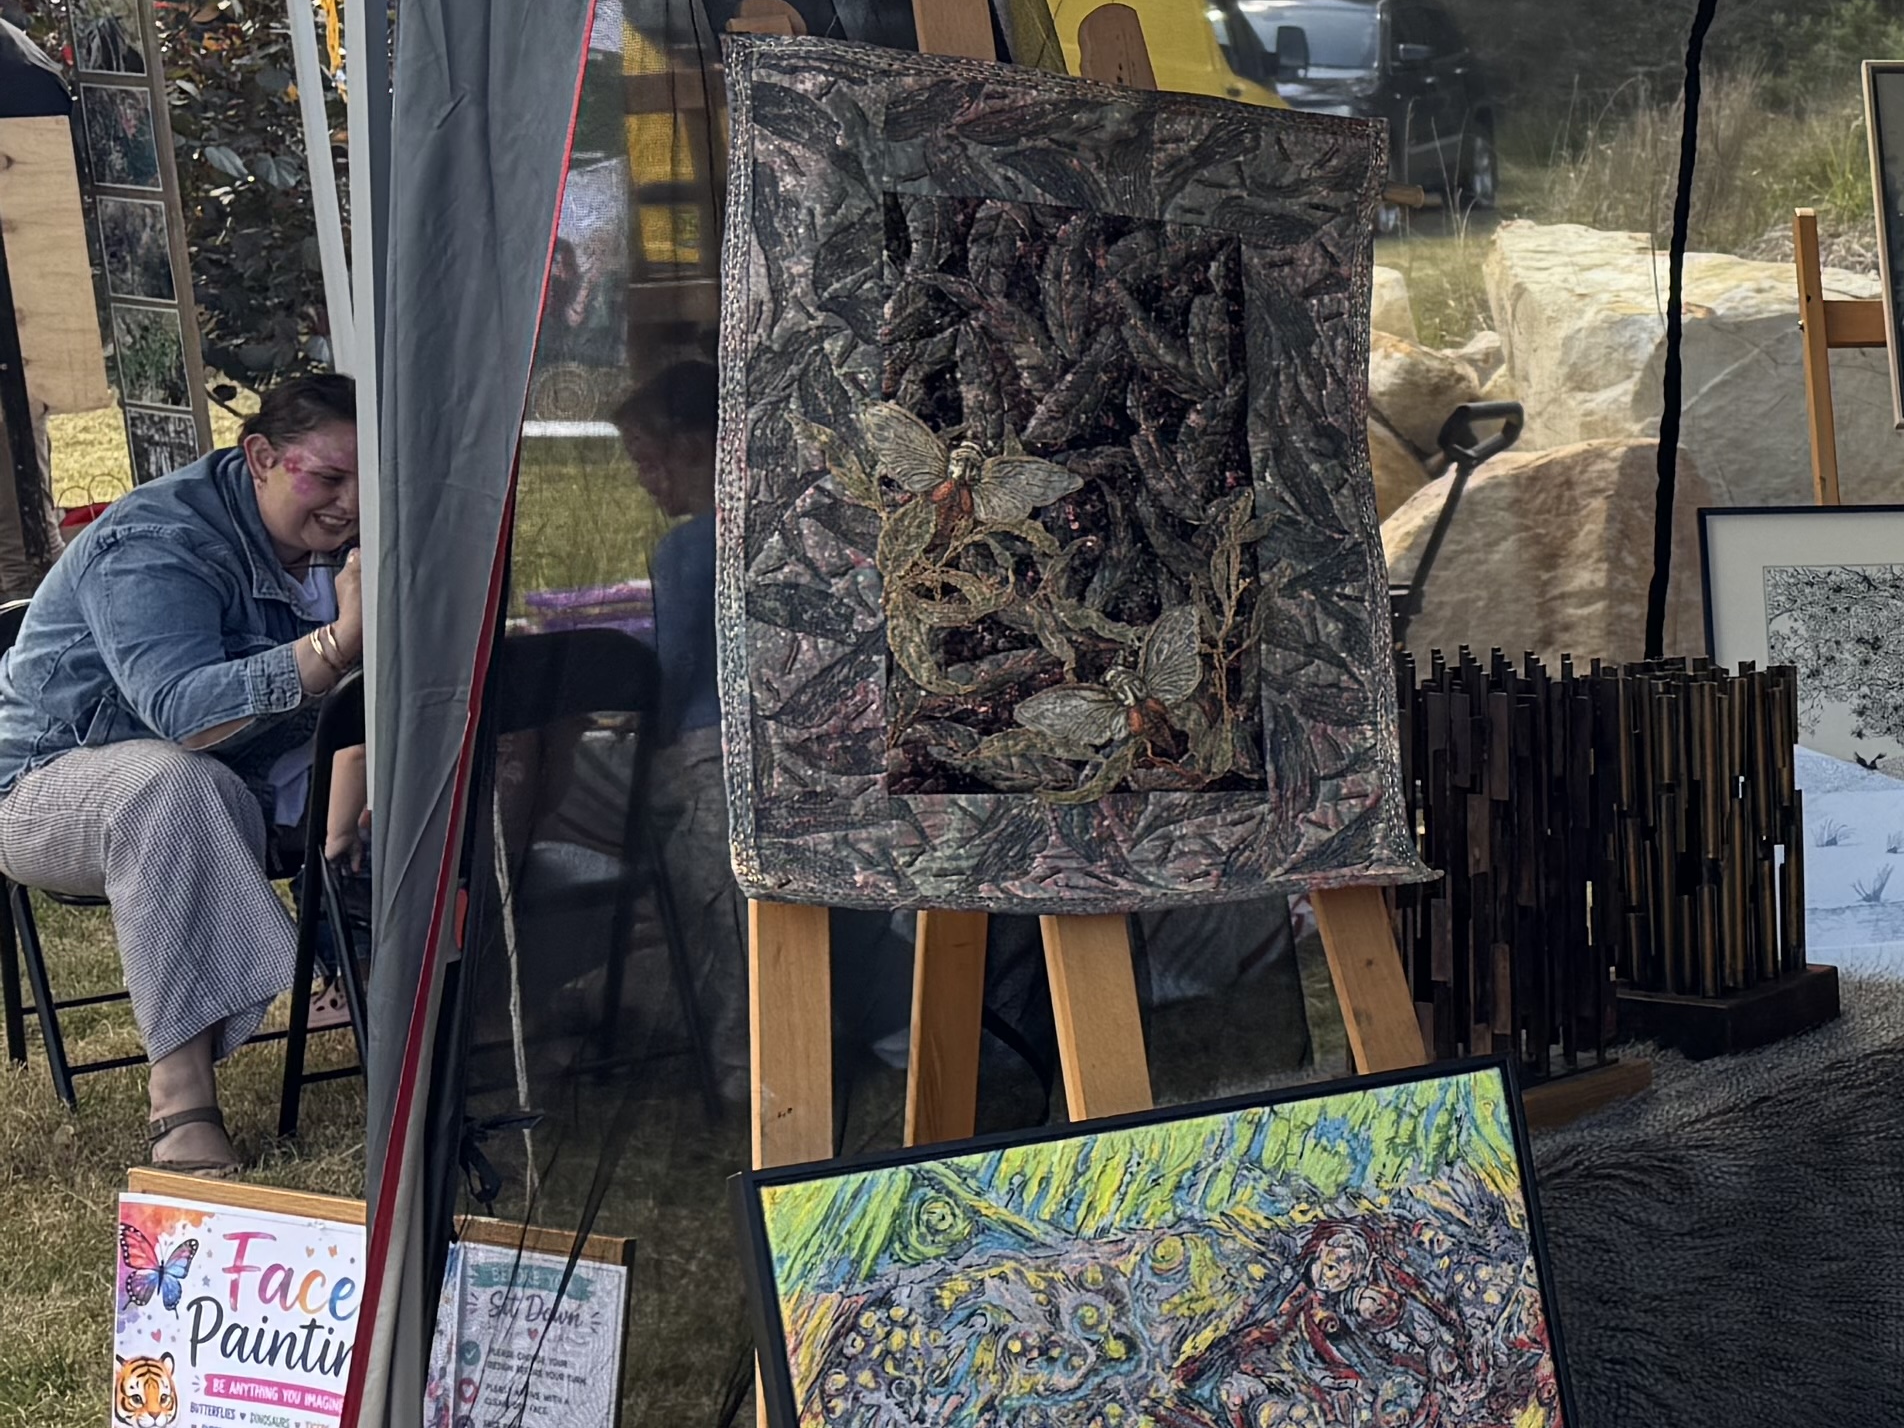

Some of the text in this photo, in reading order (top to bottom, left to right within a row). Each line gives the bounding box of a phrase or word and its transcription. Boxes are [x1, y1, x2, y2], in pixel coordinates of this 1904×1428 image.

[222, 1231, 360, 1321] Face
[492, 1266, 541, 1285] BEORE
[488, 1290, 584, 1328] Sit Down
[186, 1295, 354, 1378] Painti
[190, 1401, 236, 1421] BUTTERFLIES
[211, 1378, 344, 1413] BE ANYTHING YOU IMAGIN
